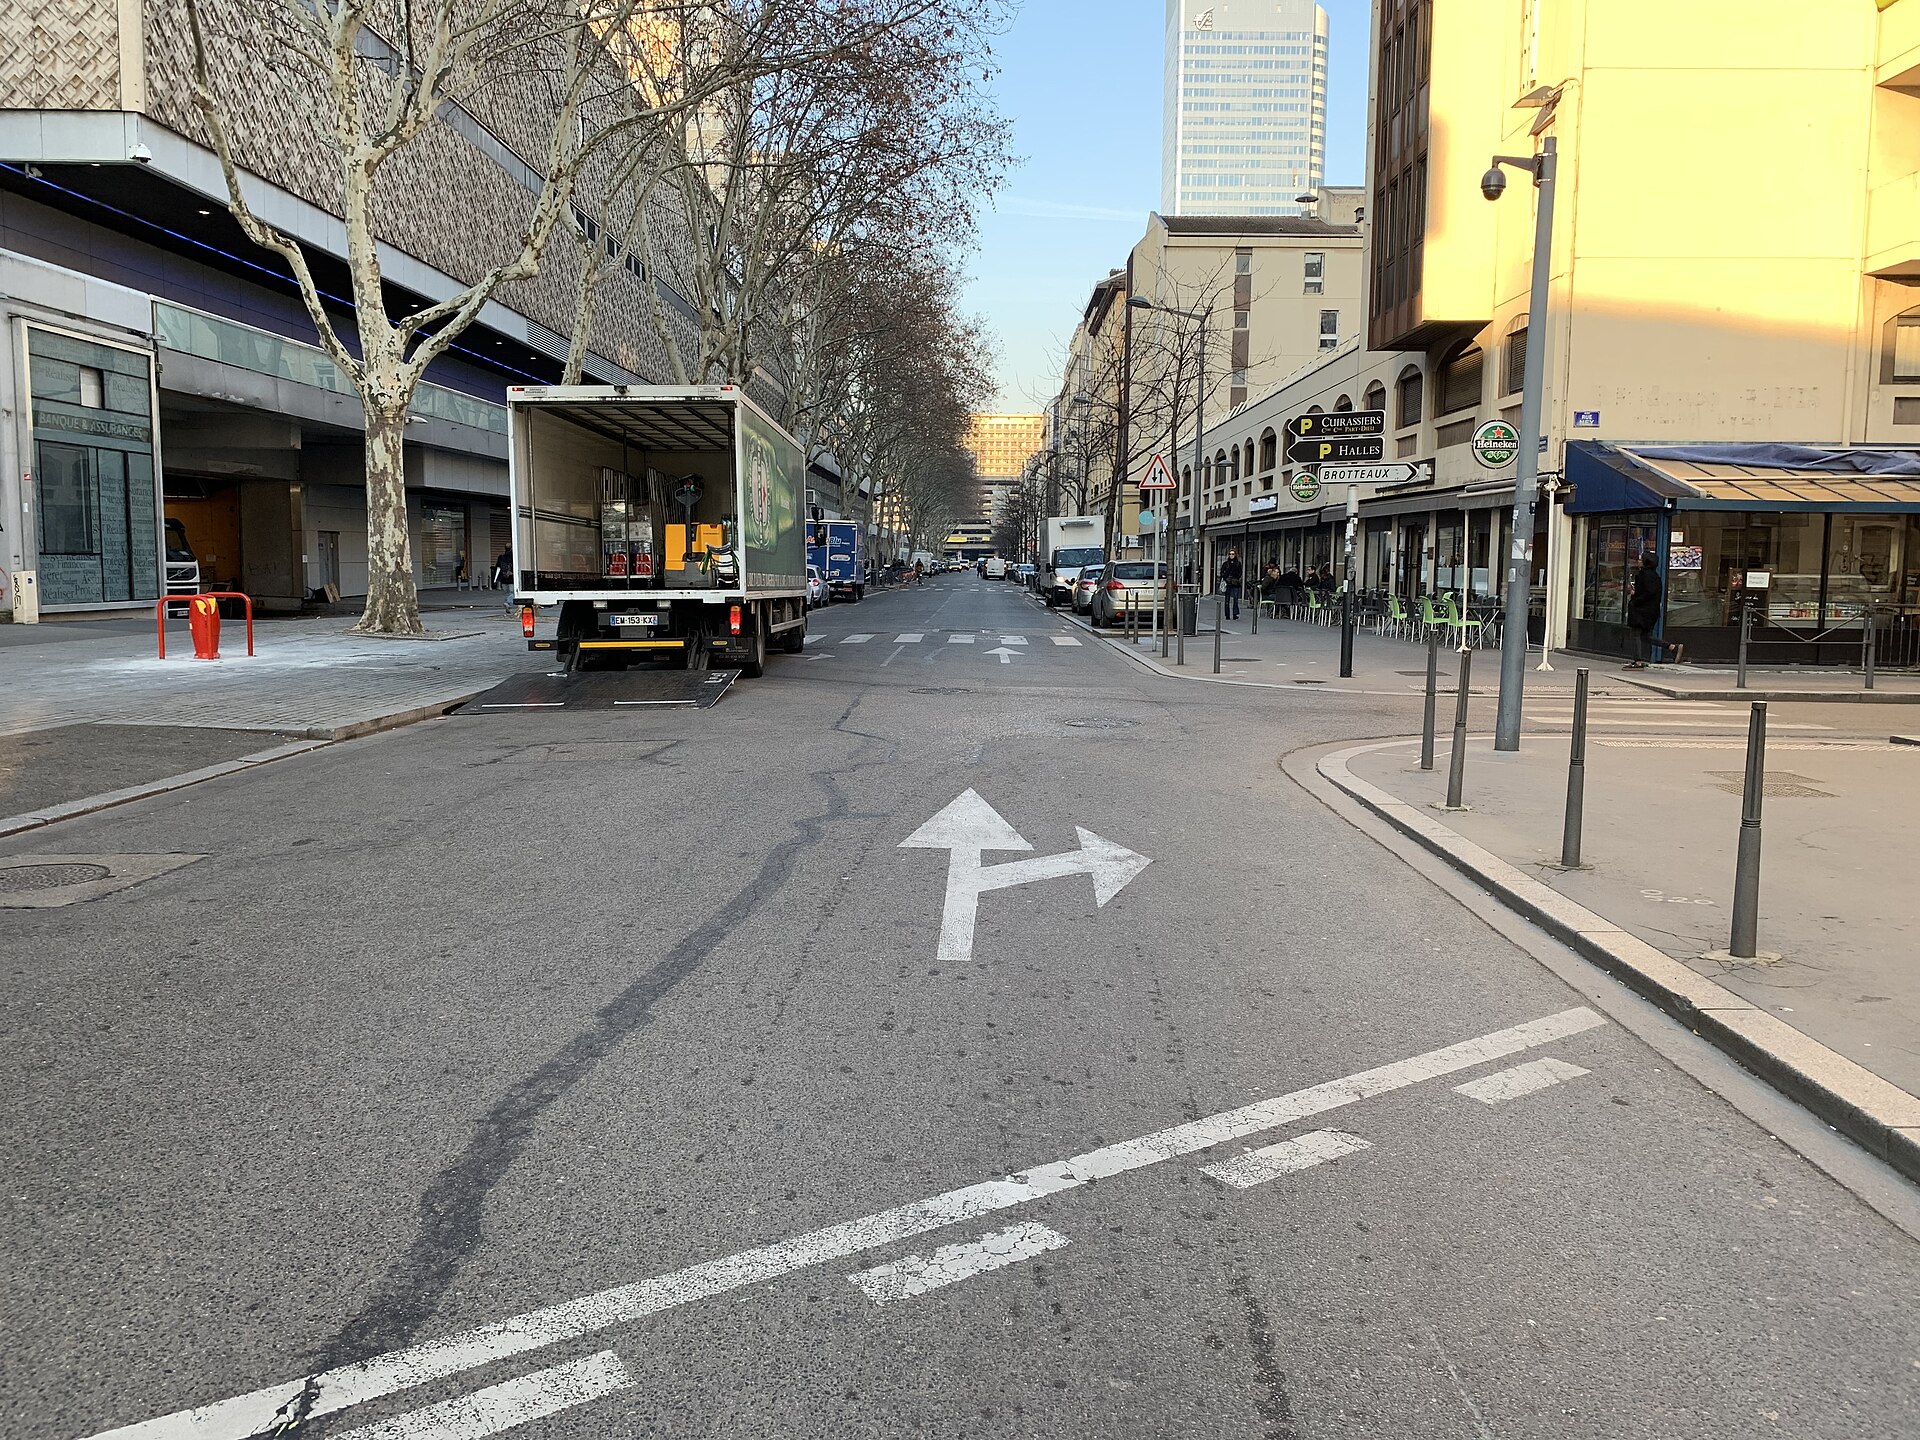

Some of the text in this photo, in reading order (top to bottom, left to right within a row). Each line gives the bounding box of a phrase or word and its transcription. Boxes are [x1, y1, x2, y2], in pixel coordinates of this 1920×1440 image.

[39, 412, 143, 438] BANQUE & ASSURANCES
[1476, 440, 1518, 449] Heineken
[1339, 445, 1380, 456] HALLES
[1323, 468, 1390, 480] BROTTEAUX
